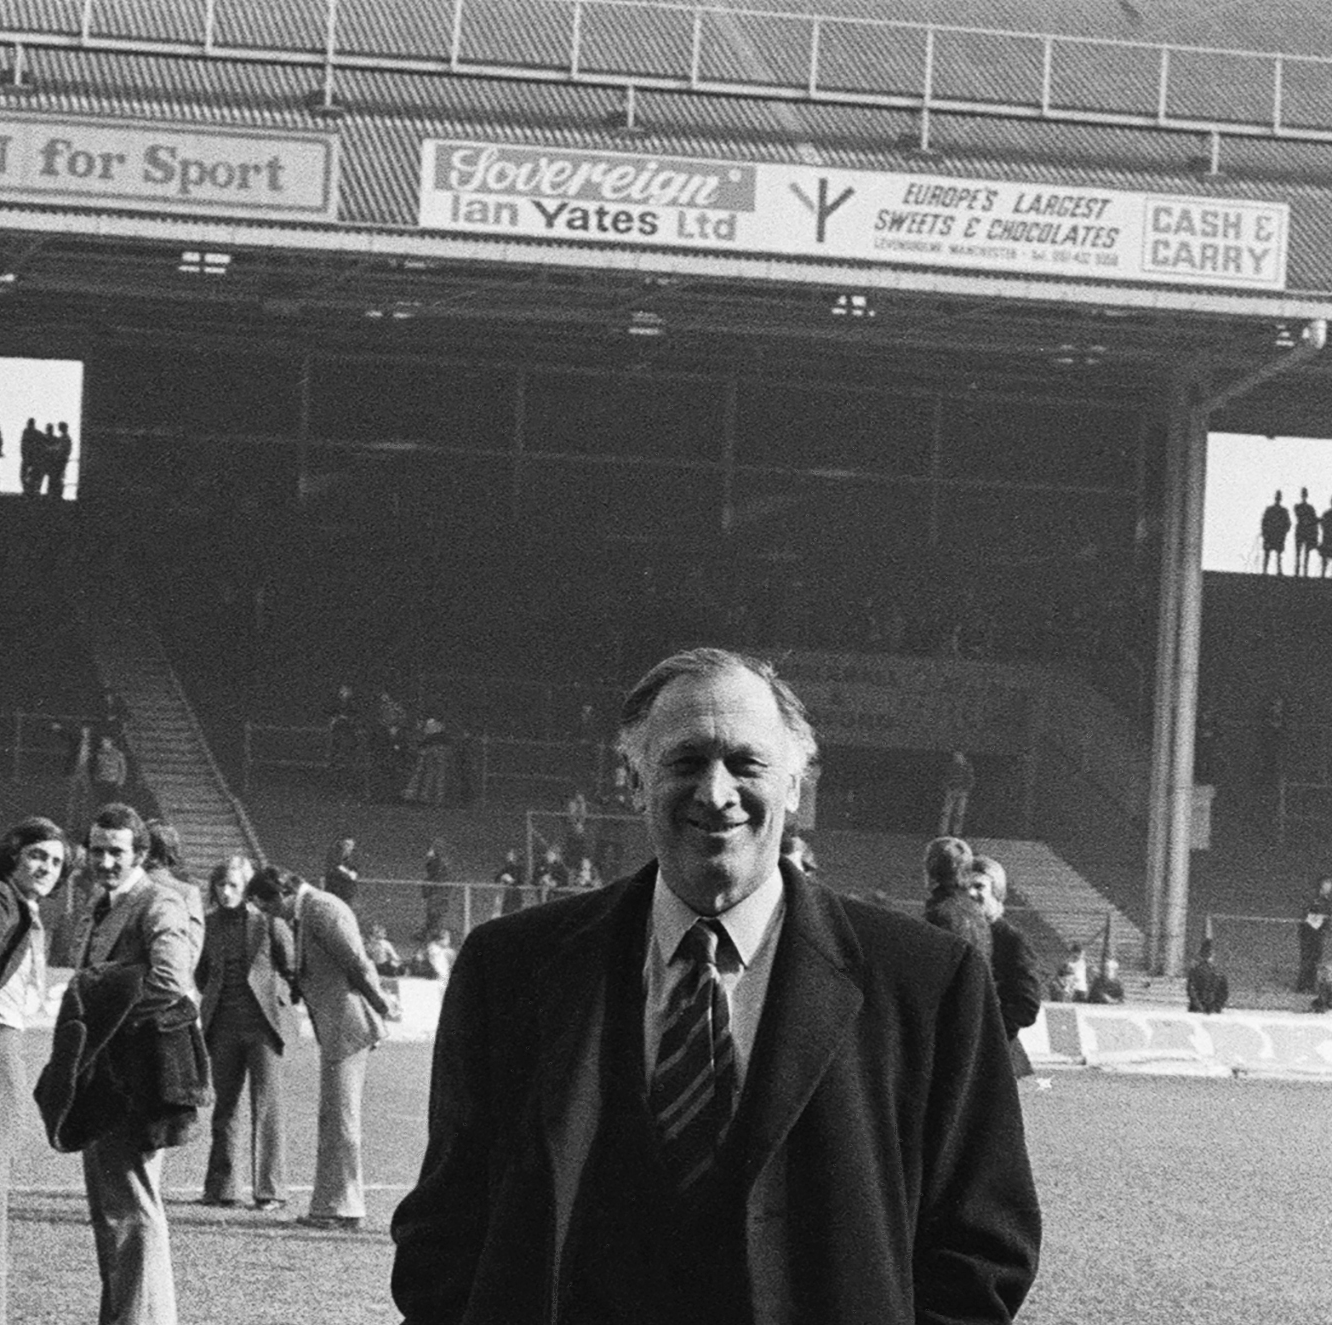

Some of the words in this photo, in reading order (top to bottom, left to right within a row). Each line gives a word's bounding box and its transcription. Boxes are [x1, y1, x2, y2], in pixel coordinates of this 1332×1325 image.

[39, 136, 127, 181] for
[141, 143, 286, 196] Sport
[450, 147, 720, 206] Sovereign
[450, 194, 519, 227] Ian
[531, 200, 660, 237] Yates
[677, 209, 738, 242] Ltd
[901, 182, 999, 212] EUROPE'S
[1011, 192, 1113, 221] LARGEST
[1151, 205, 1243, 240] CASH
[873, 208, 956, 237] SWEETS
[986, 218, 1121, 250] CHOCOLATES
[1151, 238, 1272, 275] CARRY
